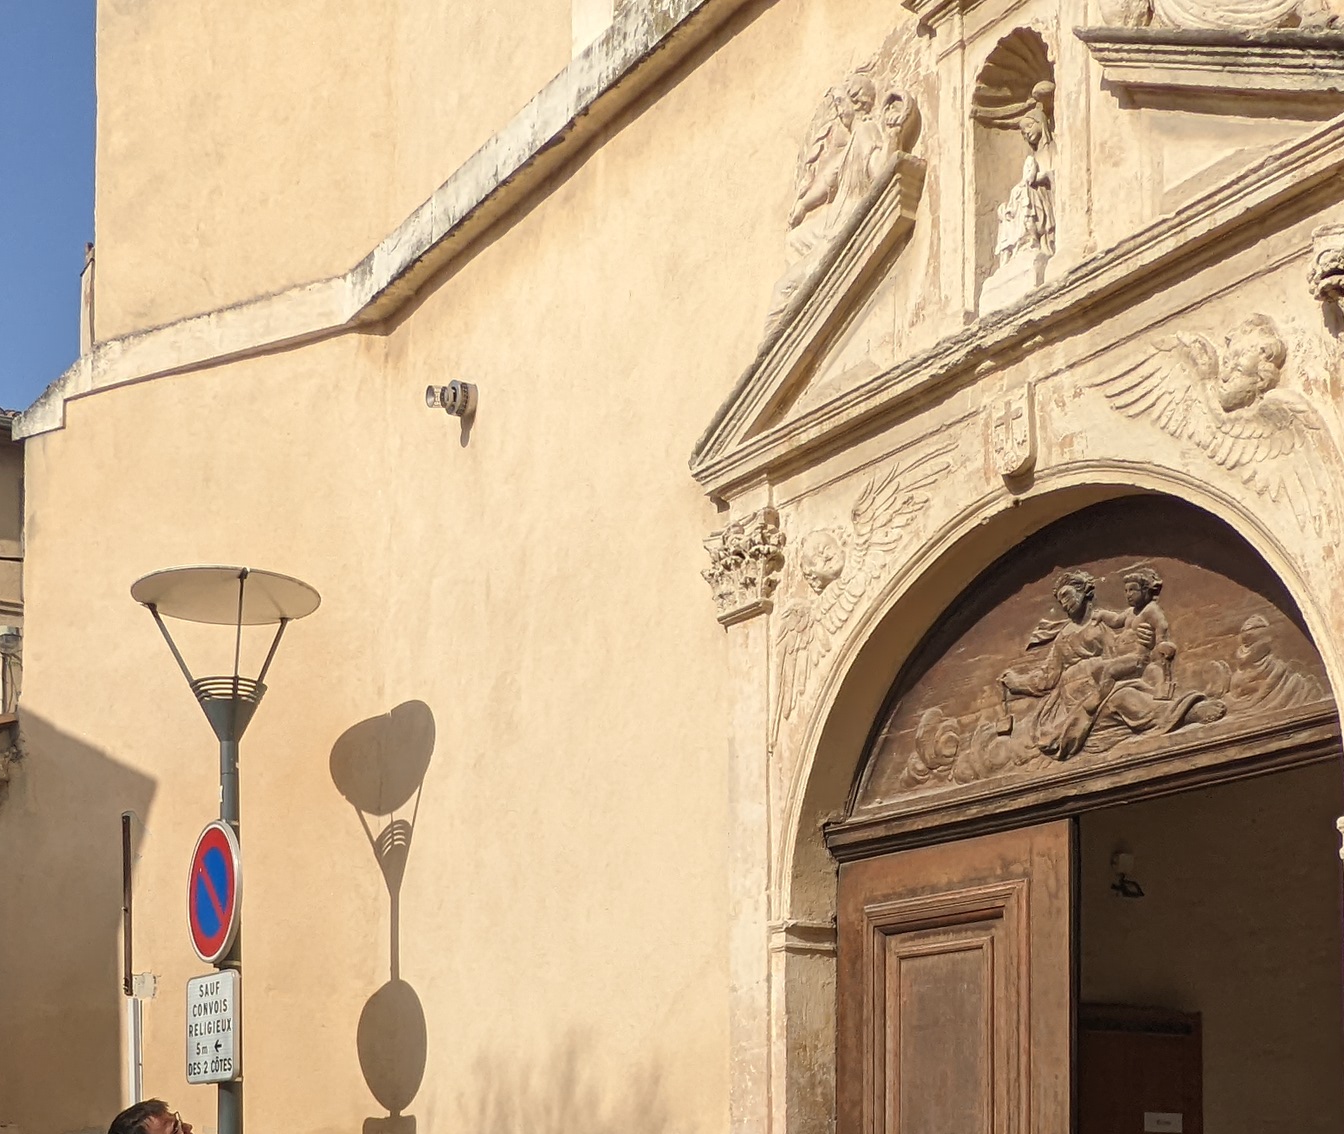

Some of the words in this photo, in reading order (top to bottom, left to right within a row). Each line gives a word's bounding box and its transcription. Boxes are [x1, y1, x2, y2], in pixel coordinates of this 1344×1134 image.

[199, 981, 220, 998] SAUF
[193, 999, 228, 1017] CONVOIS
[189, 1018, 231, 1037] RELIGIEUX
[189, 1062, 201, 1076] DES
[203, 1061, 208, 1074] 2
